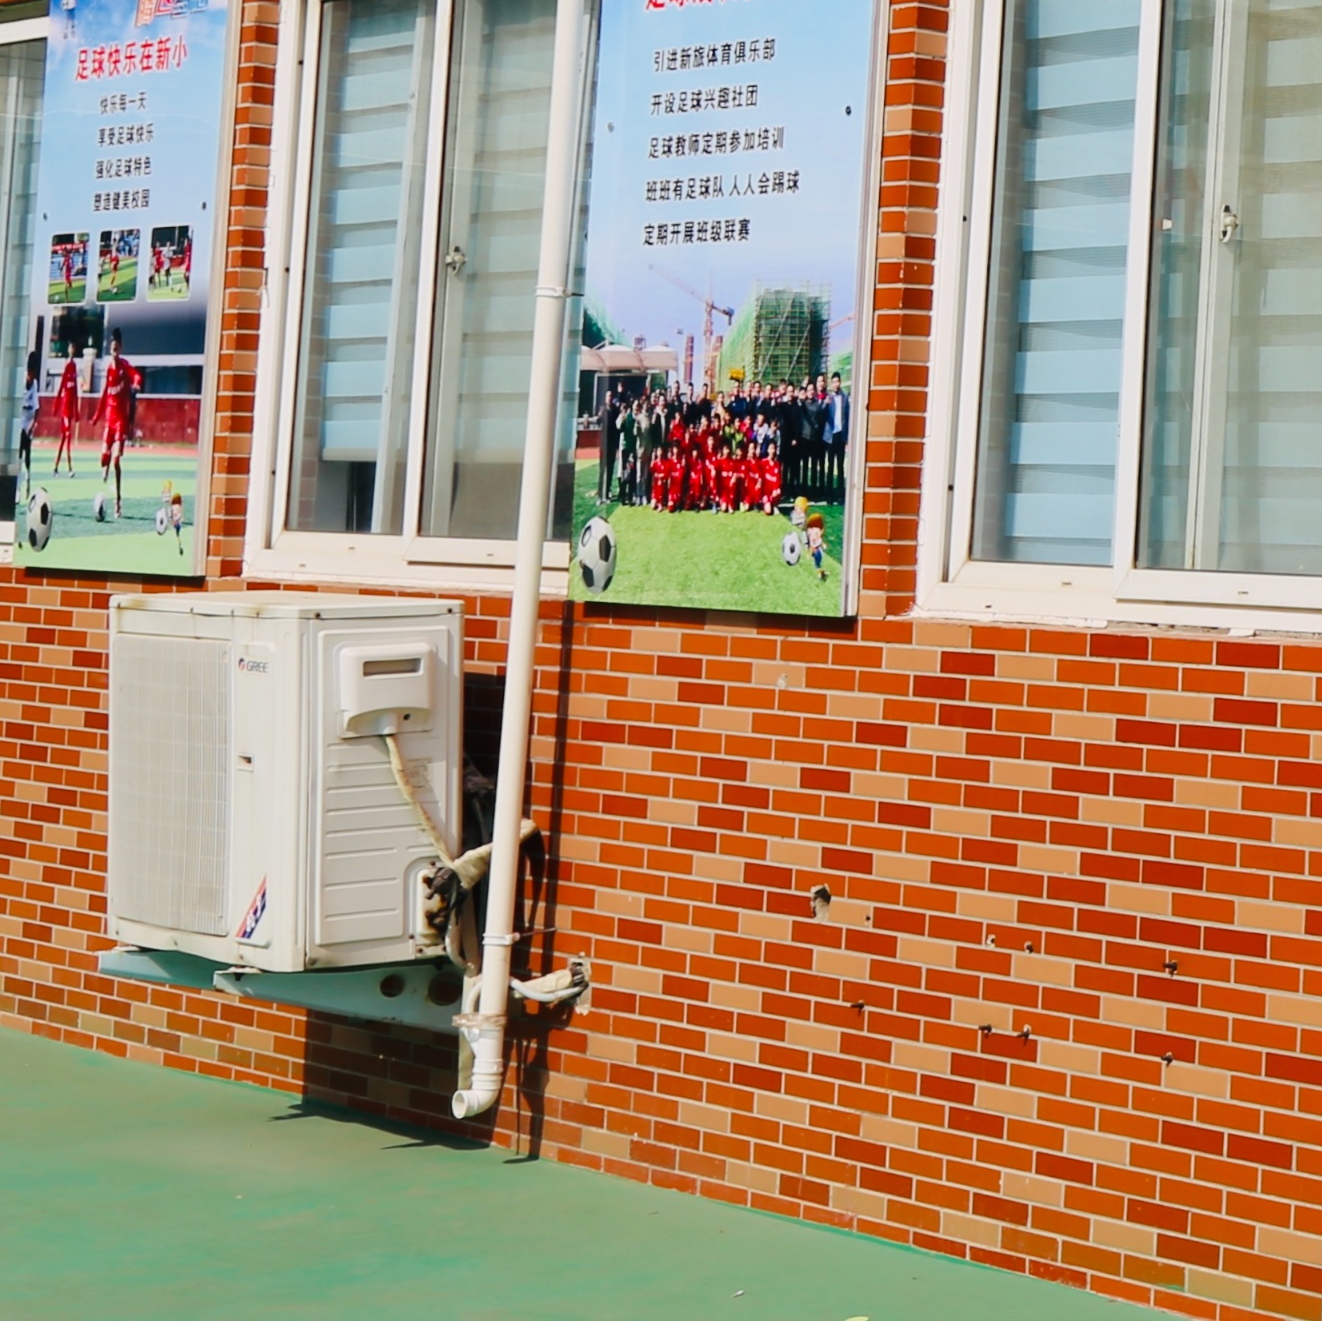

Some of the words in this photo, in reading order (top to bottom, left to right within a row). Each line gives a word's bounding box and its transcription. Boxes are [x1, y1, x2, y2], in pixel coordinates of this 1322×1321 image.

[75, 34, 187, 80] 足球快乐在新小
[100, 92, 147, 115] 快乐每一天
[650, 84, 758, 116] 开设足球兴趣社团
[98, 123, 154, 147] 享受足球快乐
[648, 126, 785, 159] 足球教师定期参加培训
[643, 218, 751, 246] 定期开展班级联赛
[246, 660, 270, 674] GREE
